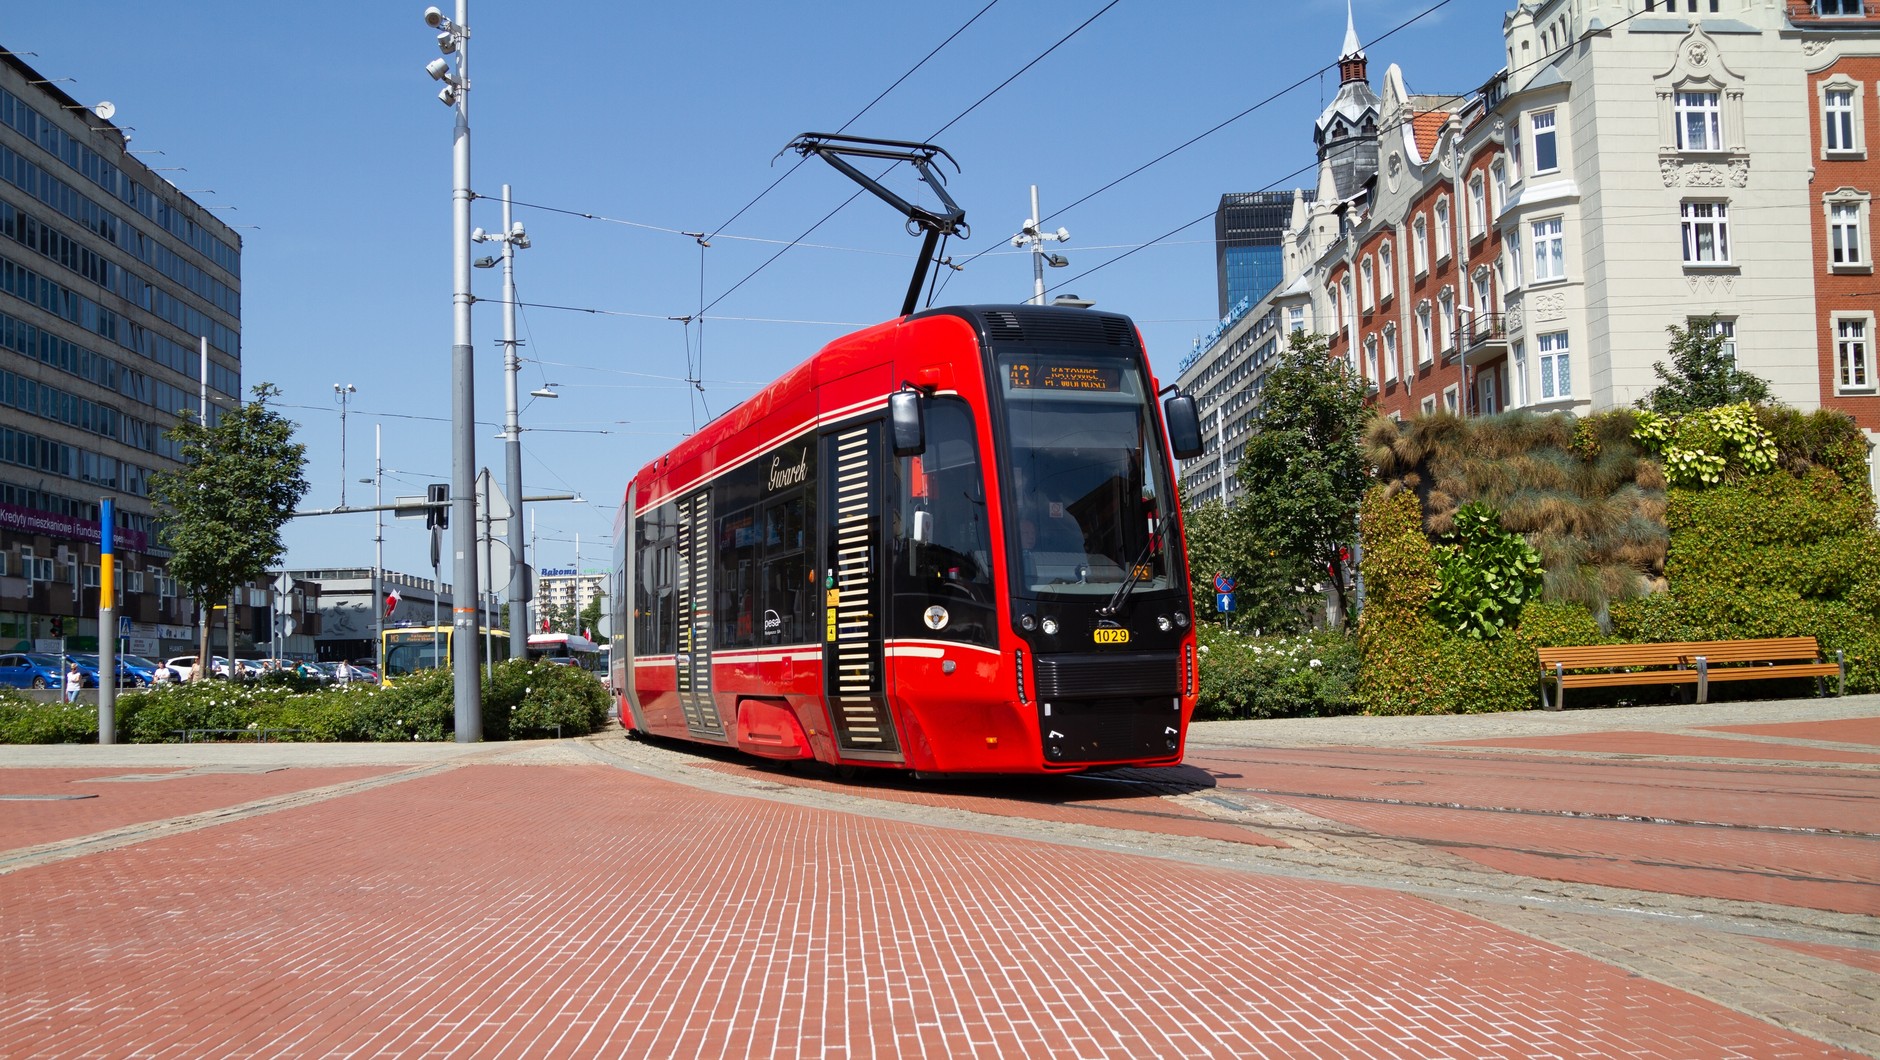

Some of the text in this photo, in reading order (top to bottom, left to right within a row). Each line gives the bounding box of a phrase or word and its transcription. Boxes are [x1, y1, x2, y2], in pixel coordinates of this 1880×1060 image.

[1051, 367, 1099, 380] KATOWICE
[768, 447, 808, 491] Gwarek
[0, 509, 27, 528] Kredyty
[27, 515, 72, 533] mieszkaniowe
[76, 523, 102, 539] Fundusz
[541, 568, 577, 577] Bakoma
[1096, 630, 1128, 642] 1029
